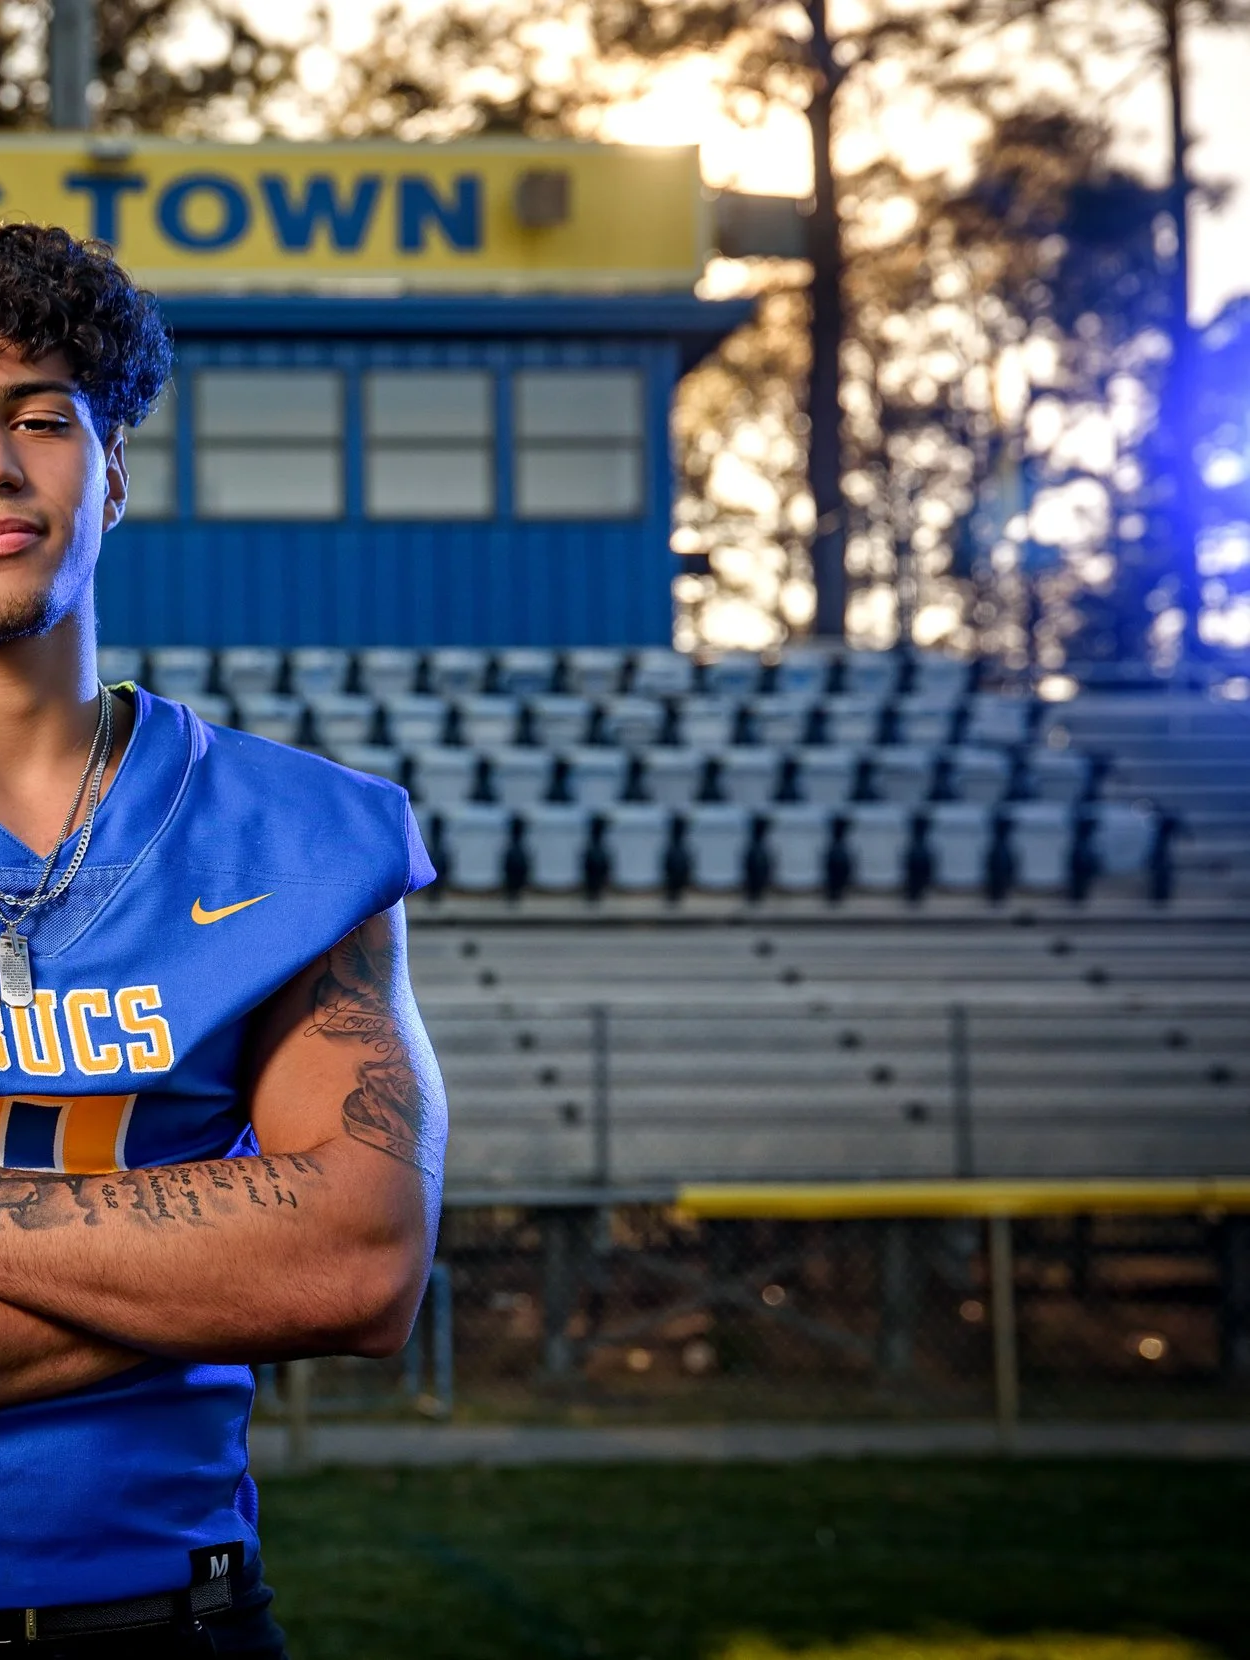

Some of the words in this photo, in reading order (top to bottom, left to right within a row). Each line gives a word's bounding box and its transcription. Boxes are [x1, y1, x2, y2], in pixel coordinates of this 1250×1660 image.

[62, 171, 482, 252] TOWN
[148, 1175, 176, 1221] burned
[180, 1187, 202, 1217] you
[243, 1176, 267, 1207] and
[210, 1553, 229, 1580] M
